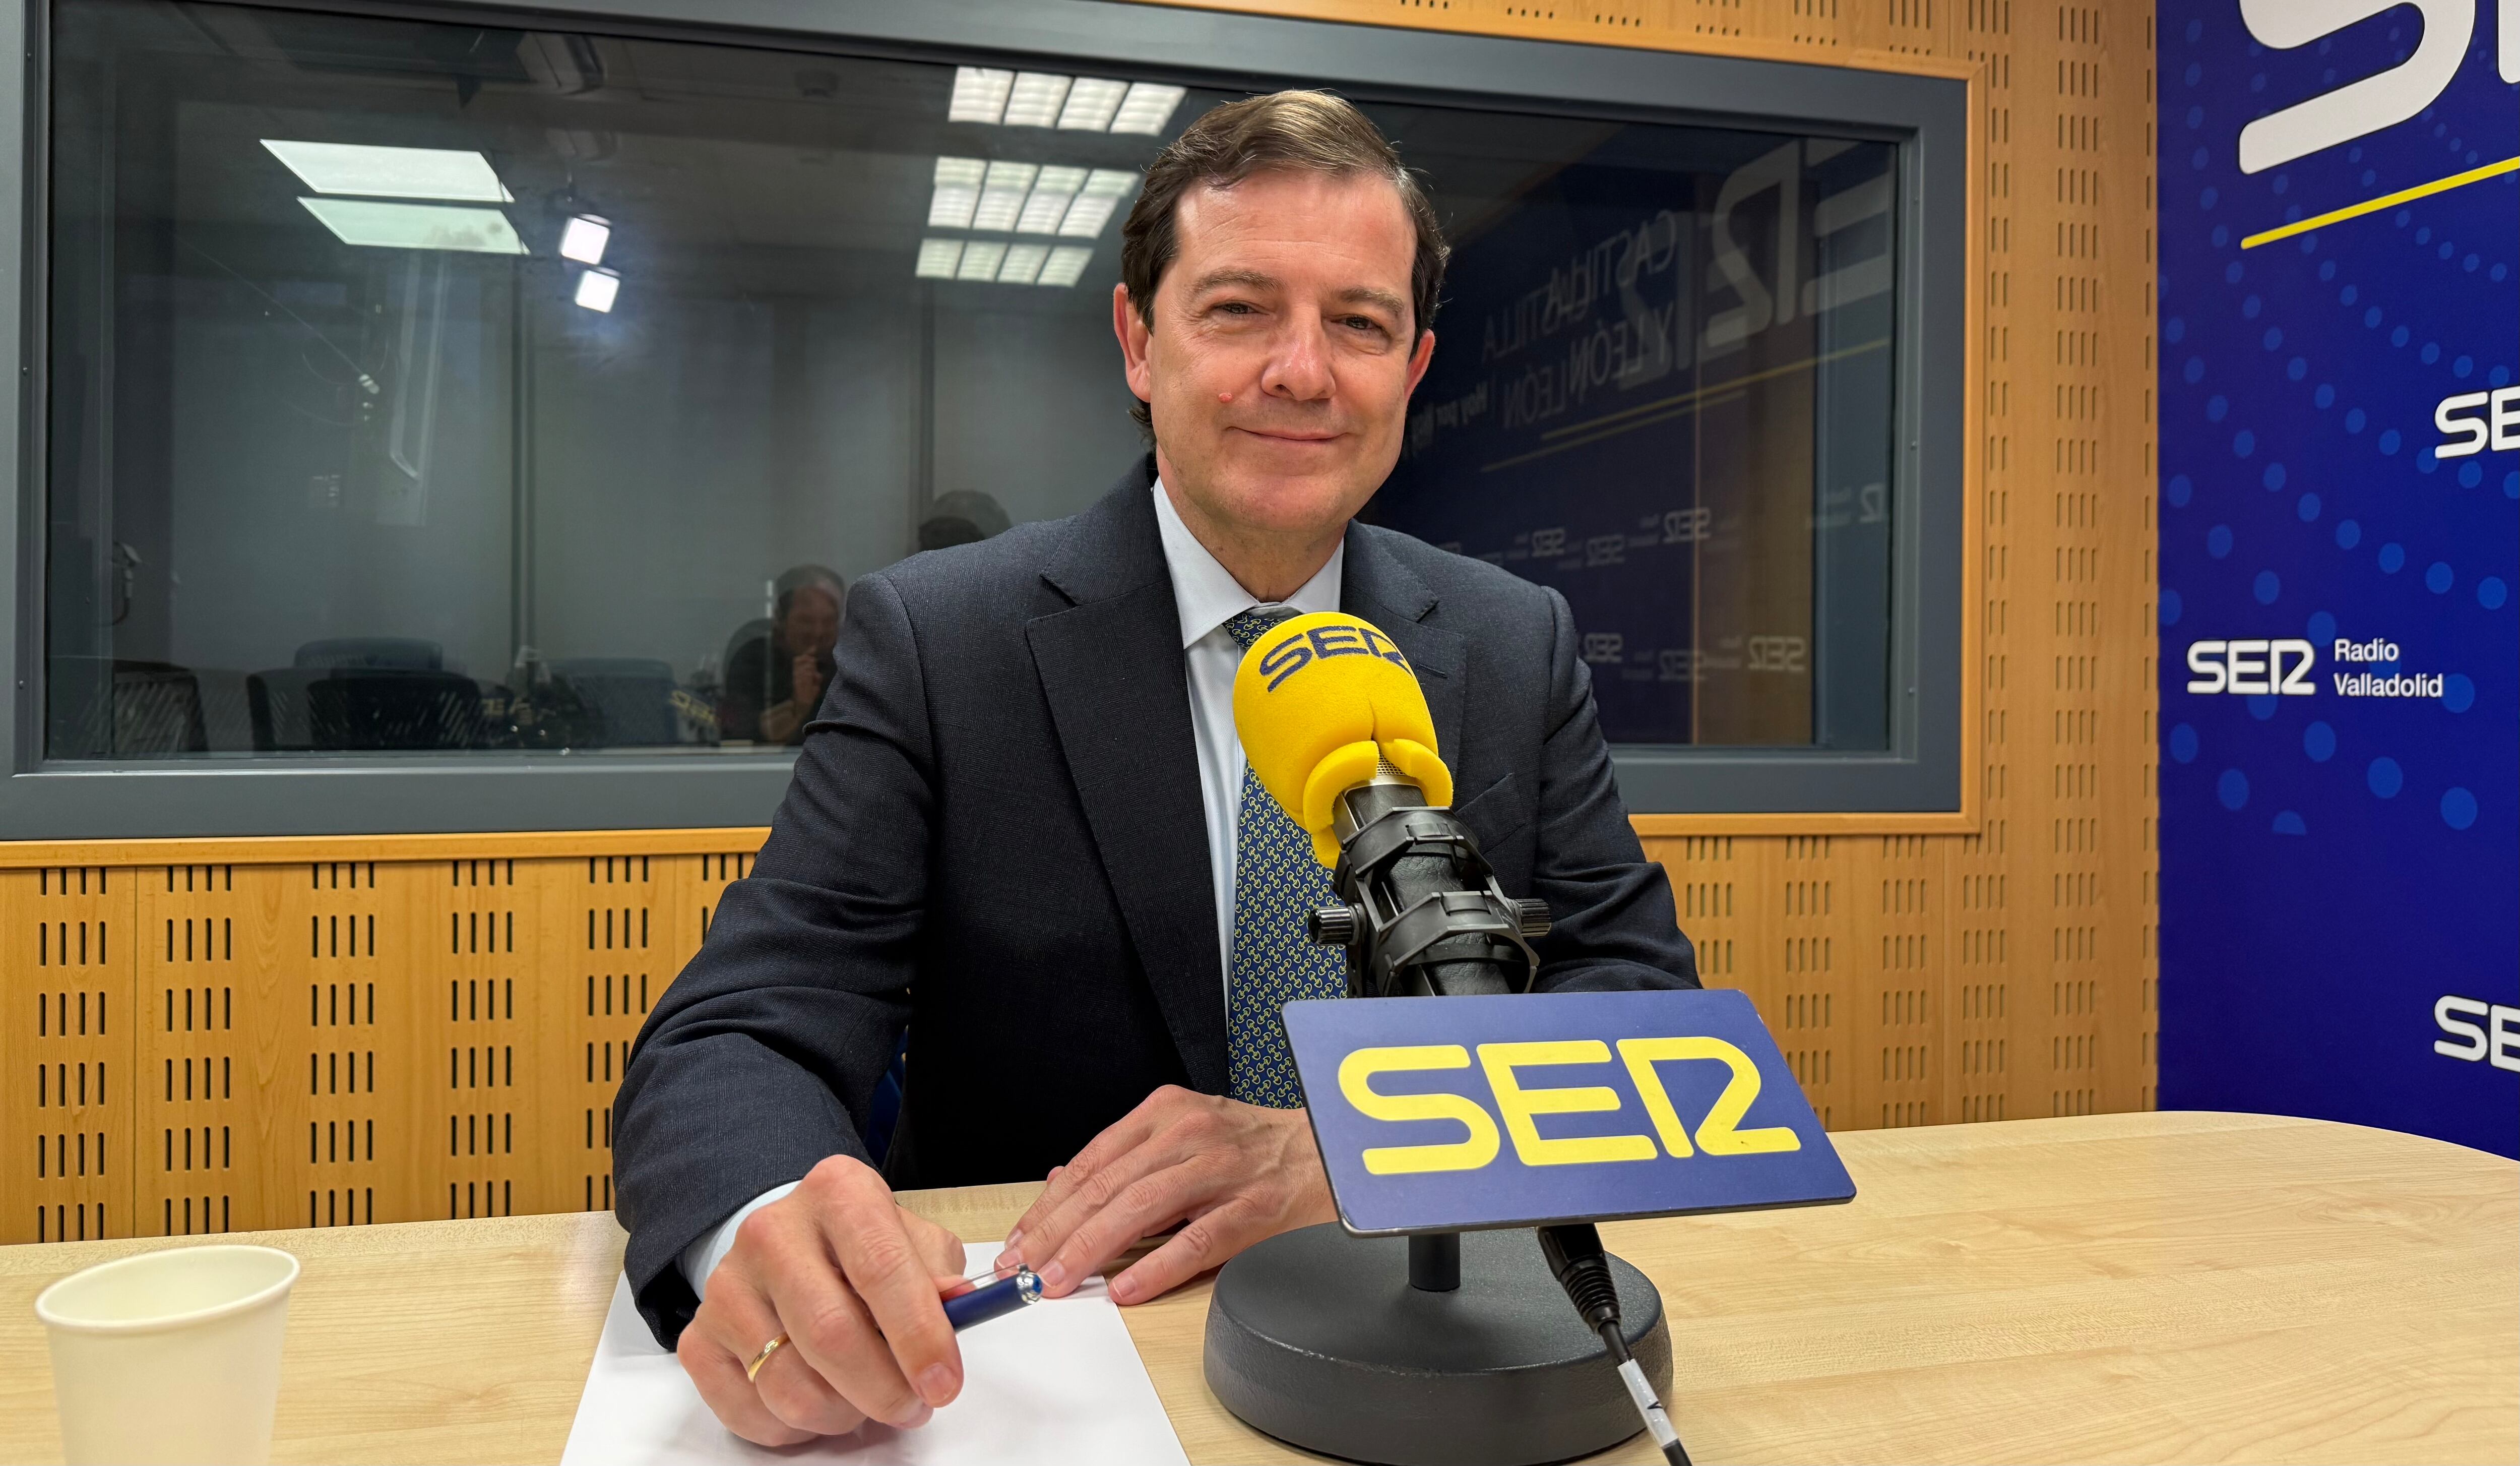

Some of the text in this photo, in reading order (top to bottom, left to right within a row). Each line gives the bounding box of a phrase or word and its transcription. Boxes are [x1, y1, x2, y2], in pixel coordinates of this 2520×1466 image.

[2187, 639, 2316, 695] SER
[2335, 638, 2399, 662] Radio
[2334, 673, 2443, 698] Valladolid
[1338, 1036, 1801, 1175] SER
